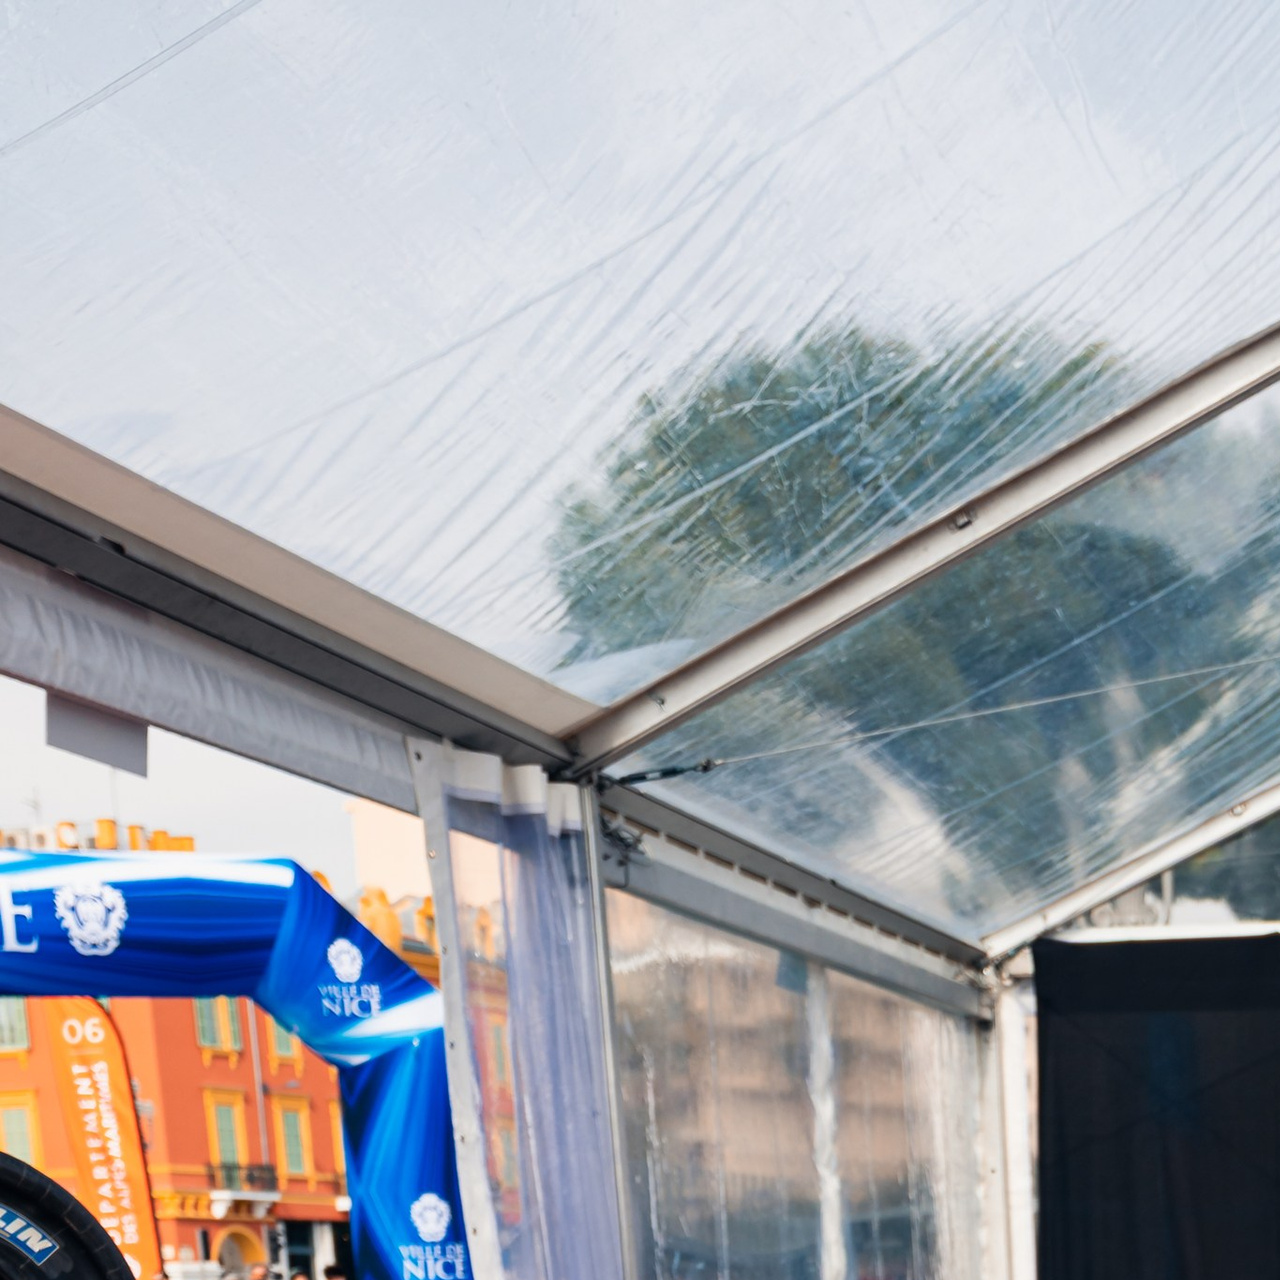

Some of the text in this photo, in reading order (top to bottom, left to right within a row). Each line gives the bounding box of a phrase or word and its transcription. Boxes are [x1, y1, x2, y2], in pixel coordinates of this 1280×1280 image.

[321, 998, 381, 1018] NICE
[62, 1017, 105, 1044] 06
[402, 1258, 466, 1280] NICE
